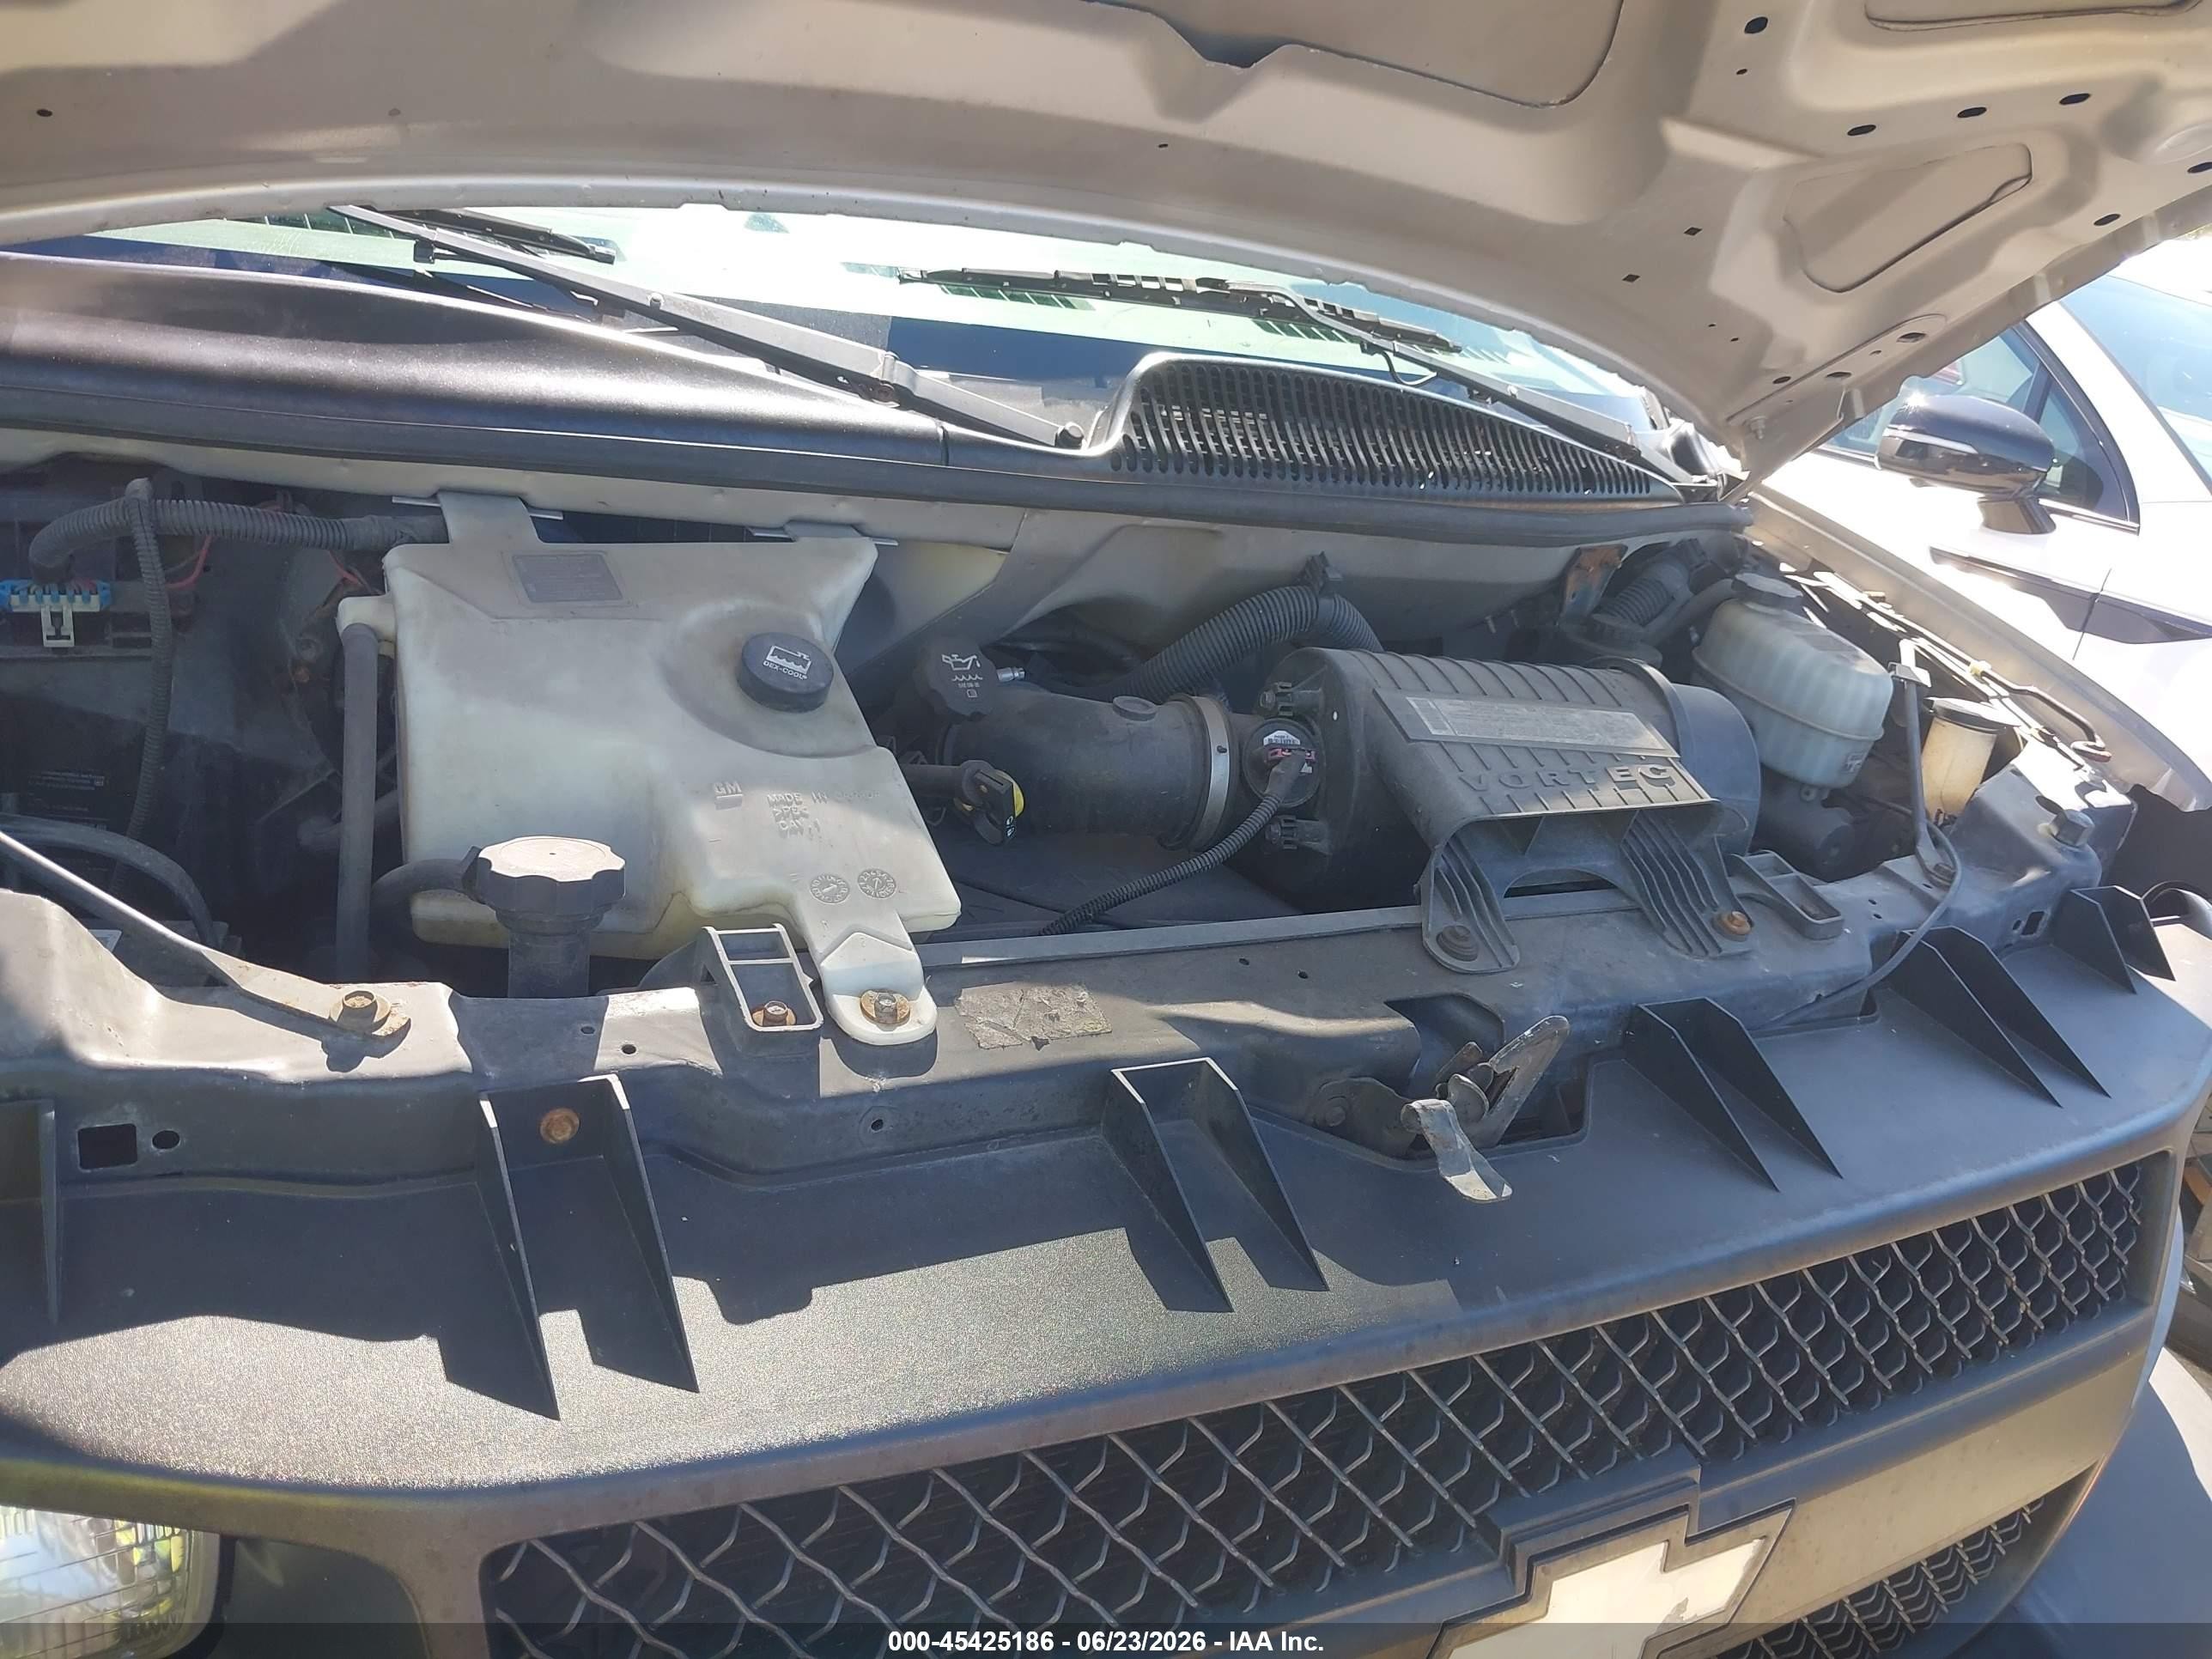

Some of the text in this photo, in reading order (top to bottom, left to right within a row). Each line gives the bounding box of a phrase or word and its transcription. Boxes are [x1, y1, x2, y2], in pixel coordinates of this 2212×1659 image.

[1458, 763, 1676, 793] VORTEC
[714, 781, 743, 796] GM
[767, 792, 804, 805] MADE
